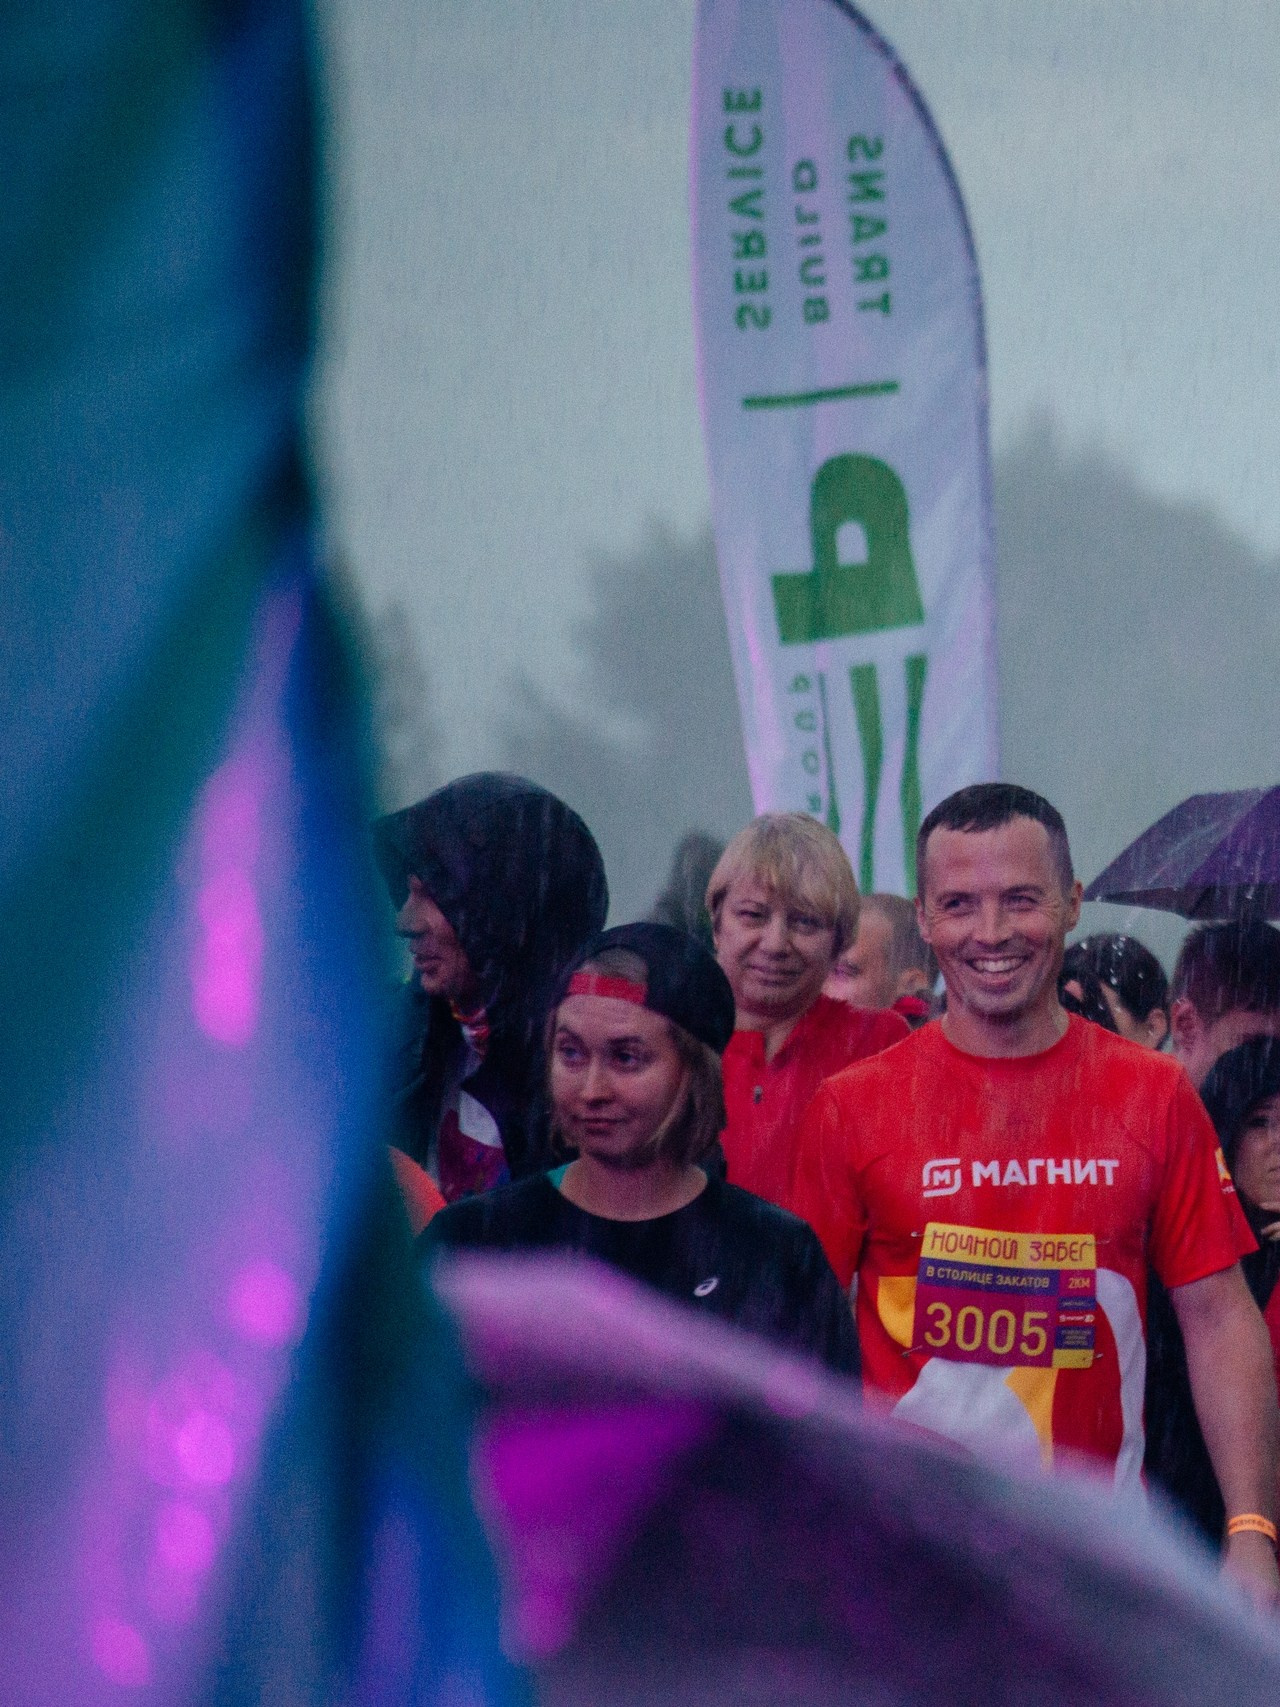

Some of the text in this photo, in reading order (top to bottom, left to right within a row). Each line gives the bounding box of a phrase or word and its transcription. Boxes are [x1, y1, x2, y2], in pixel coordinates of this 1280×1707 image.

[971, 1157, 1120, 1188] МАГНИТ
[930, 1230, 1090, 1262] НОЧНОЙ ЗАБЕГ
[926, 1265, 1051, 1289] В СТОЛИЦЕ ЗАКАТОВ
[923, 1300, 1049, 1357] 3005
